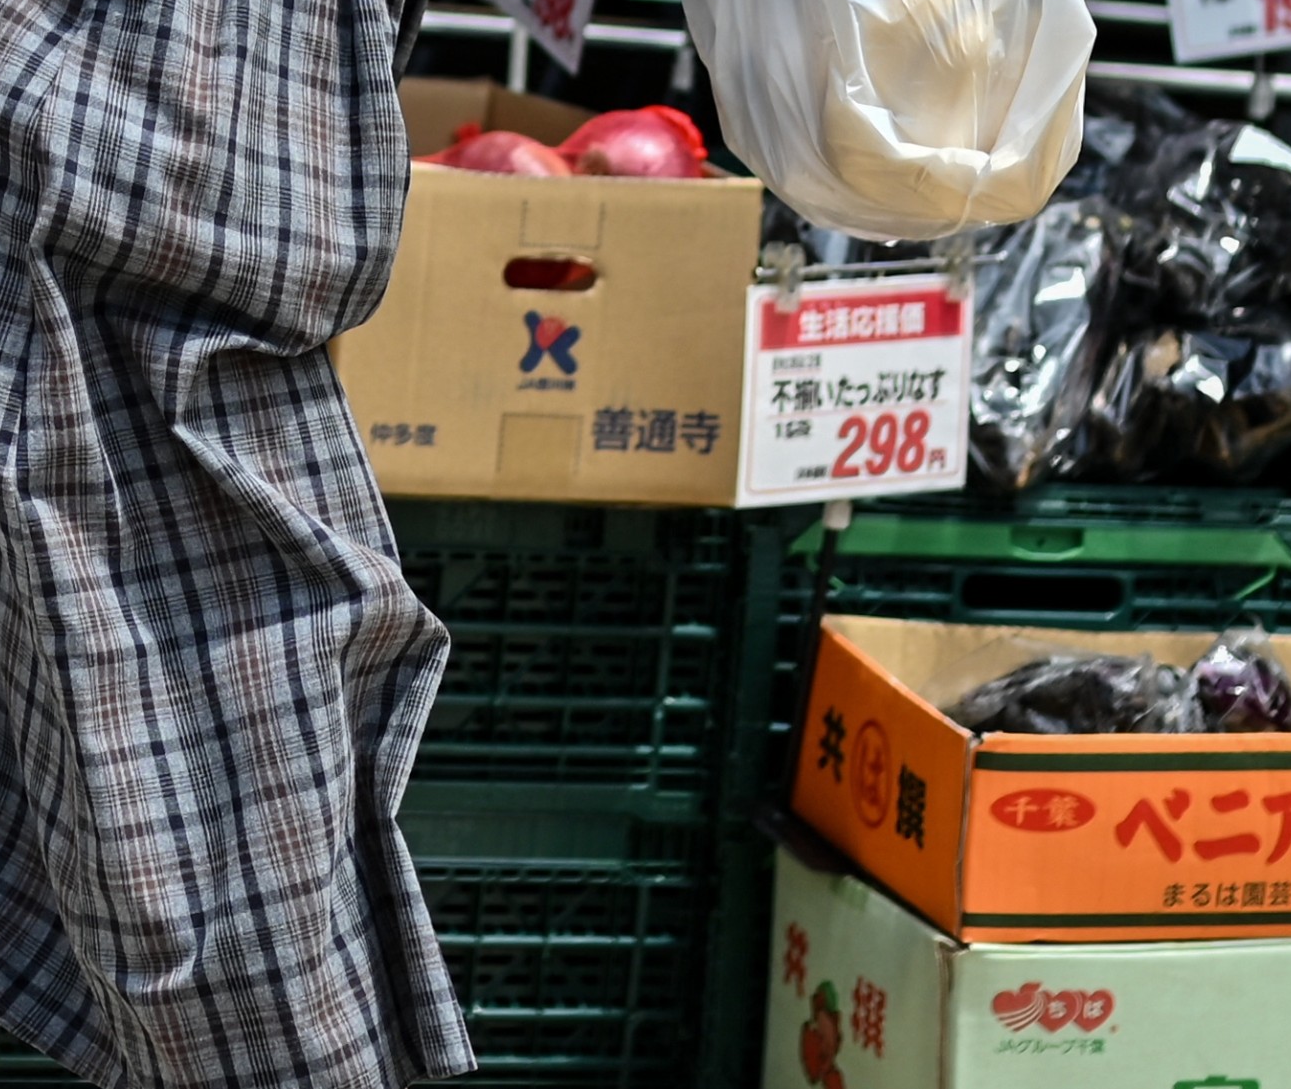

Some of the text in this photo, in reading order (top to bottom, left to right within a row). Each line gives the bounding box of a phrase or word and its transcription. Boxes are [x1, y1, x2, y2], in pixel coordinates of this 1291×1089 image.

[593, 406, 721, 456] 善通寺
[1004, 795, 1080, 828] 千葉
